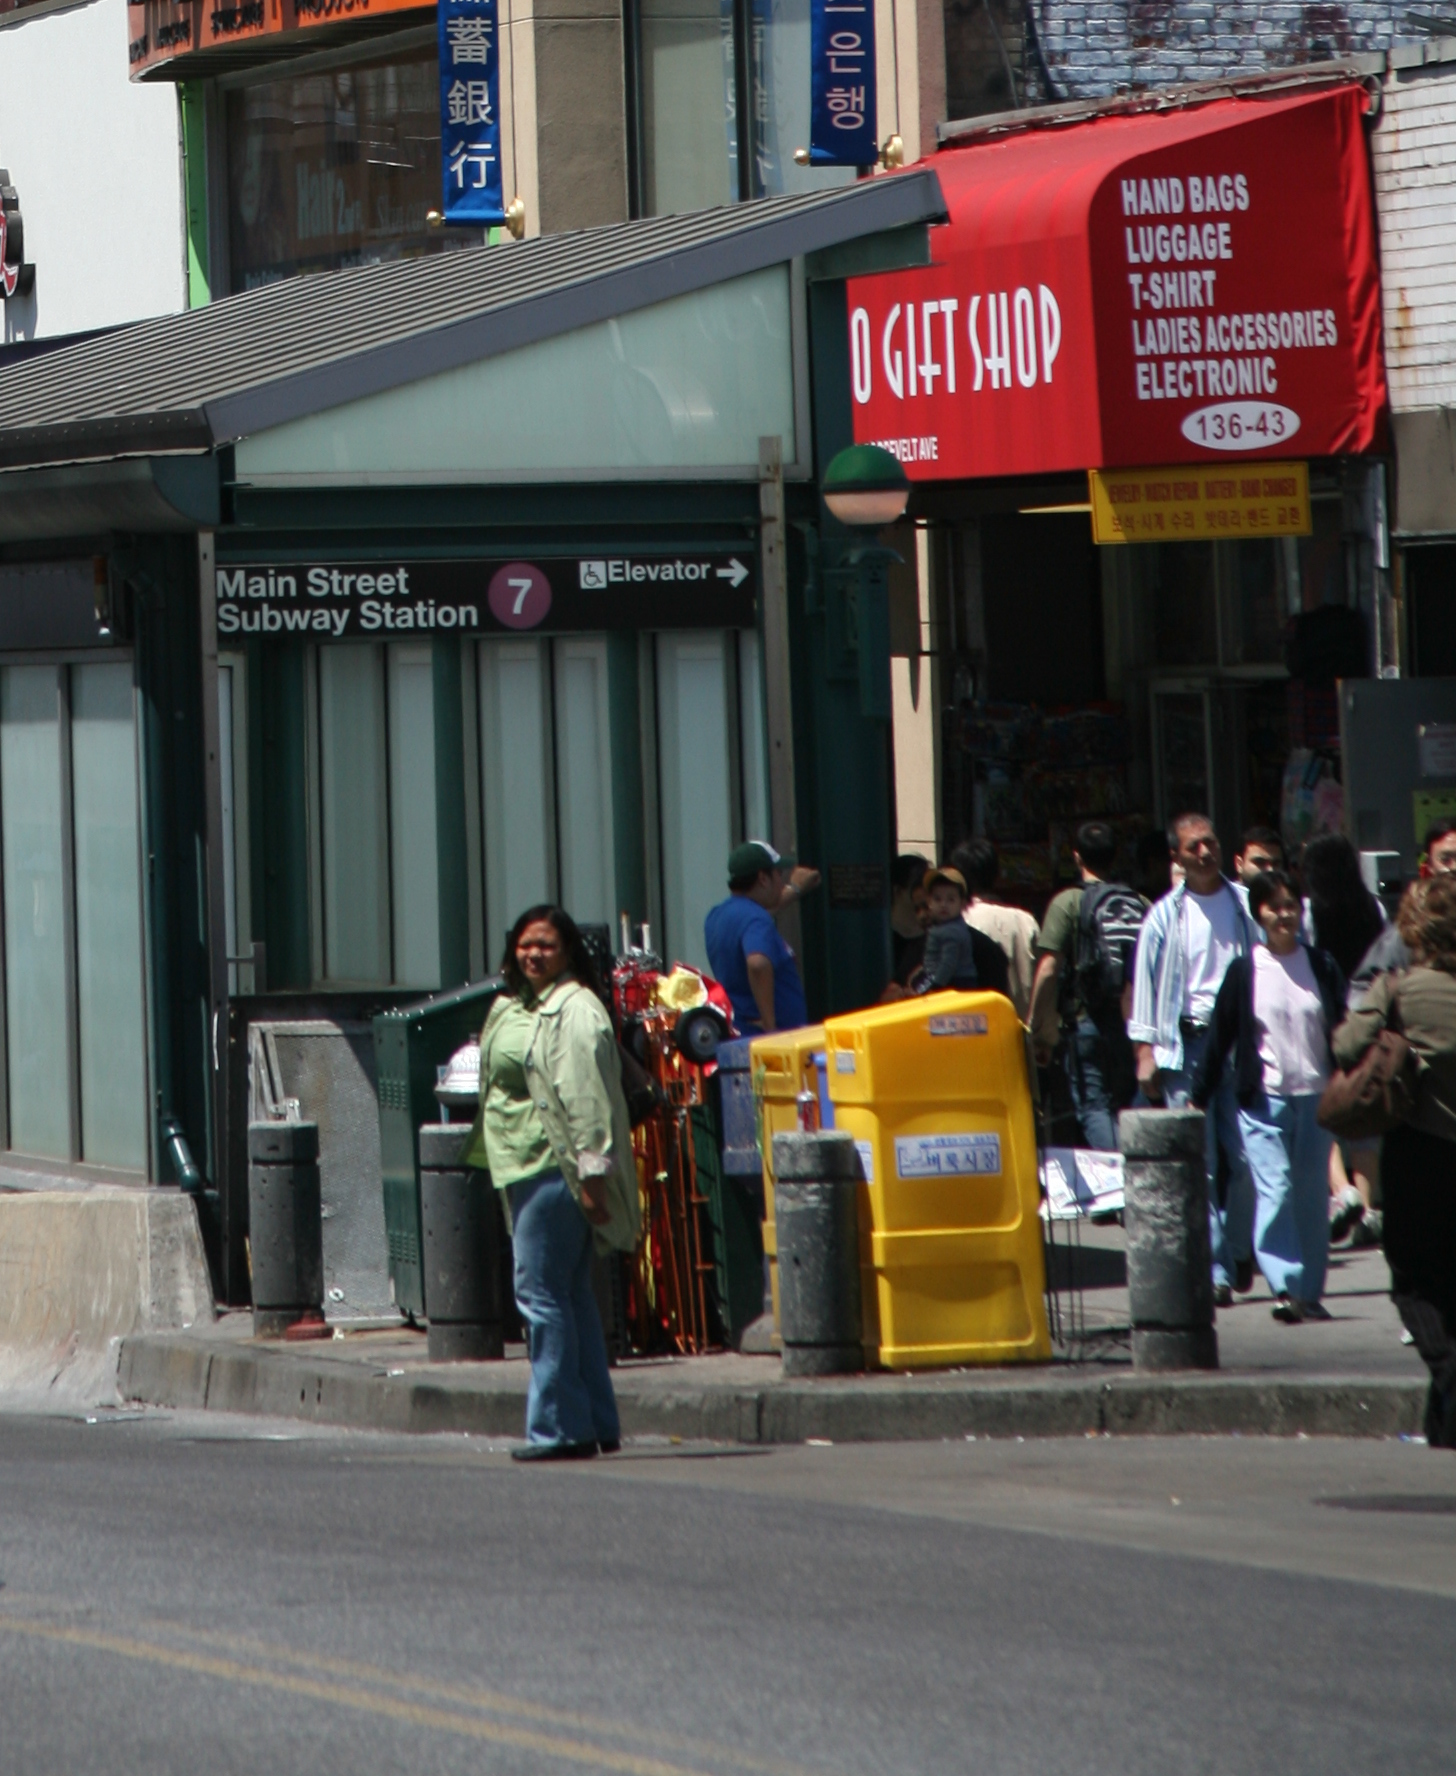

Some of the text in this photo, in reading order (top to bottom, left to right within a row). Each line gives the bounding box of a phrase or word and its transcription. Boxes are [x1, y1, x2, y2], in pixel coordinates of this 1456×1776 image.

[1121, 174, 1250, 216] HAND BAGS
[1126, 223, 1233, 264] LUGGAGE
[1129, 271, 1217, 310] T-SHIRT
[883, 298, 959, 400] GIFT
[969, 284, 1062, 394] SHOP
[1132, 310, 1339, 357] LADIES ACCESSORIES
[1136, 356, 1278, 401] ELECTRONIC
[1196, 411, 1287, 441] 136-43
[920, 436, 938, 461] AVE
[217, 567, 410, 600] Main Street
[607, 560, 711, 582] Elevator
[507, 578, 533, 615] 7
[218, 600, 478, 636] Subway Station
